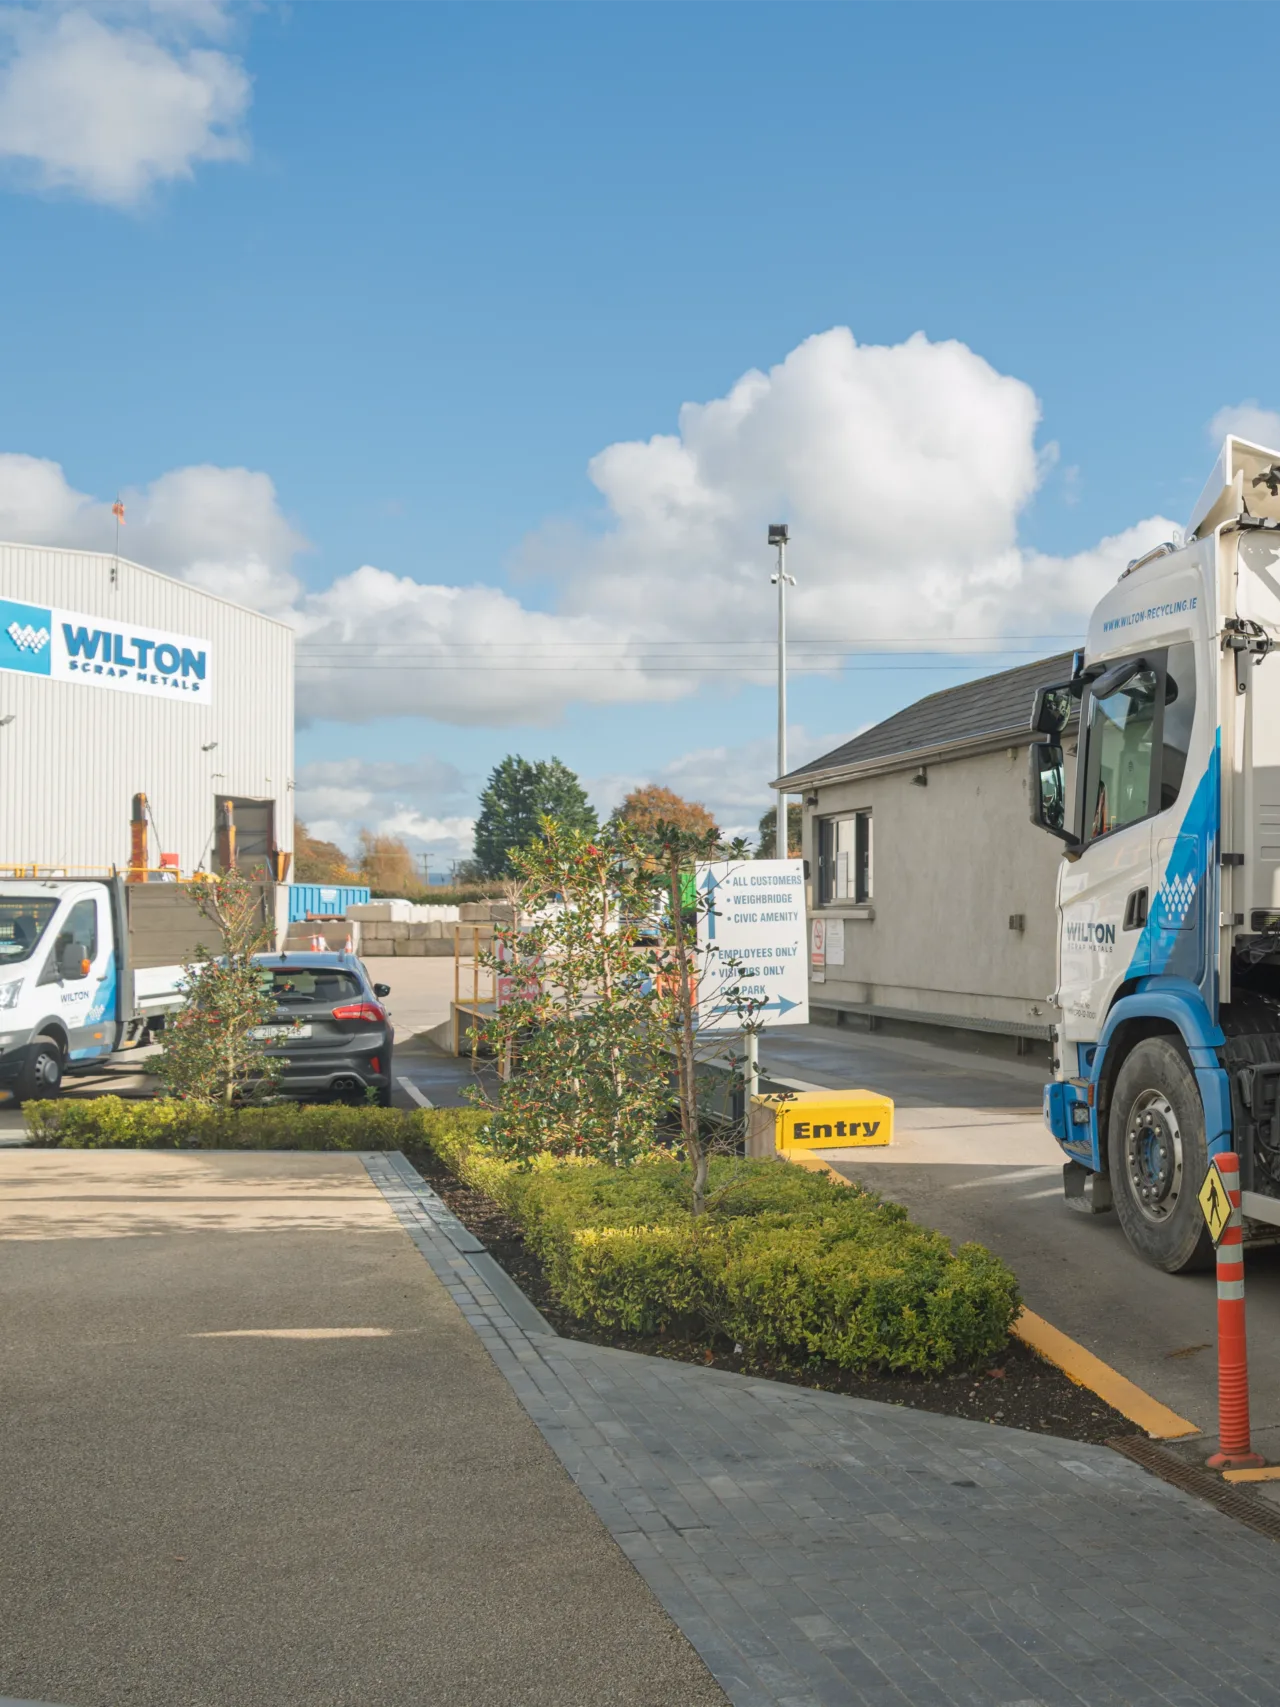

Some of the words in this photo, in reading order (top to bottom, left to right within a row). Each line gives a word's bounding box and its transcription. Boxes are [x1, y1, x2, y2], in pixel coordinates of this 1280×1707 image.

[61, 622, 206, 680] WILTON
[68, 660, 128, 678] SCRAP
[136, 672, 200, 692] METALS
[732, 876, 748, 887] ALL
[750, 875, 802, 886] CUSTOMERS
[733, 893, 793, 905] WEIGHBRIDGE
[734, 912, 758, 924] CIVIC
[760, 911, 799, 922] AMENITY
[1066, 921, 1116, 945] WILTON
[718, 947, 773, 960] EMPLOYEES
[775, 946, 798, 957] ONLY
[763, 965, 785, 976] ONLY
[61, 991, 90, 1003] WILTON
[741, 985, 767, 996] PARK
[793, 1120, 881, 1140] Entry
